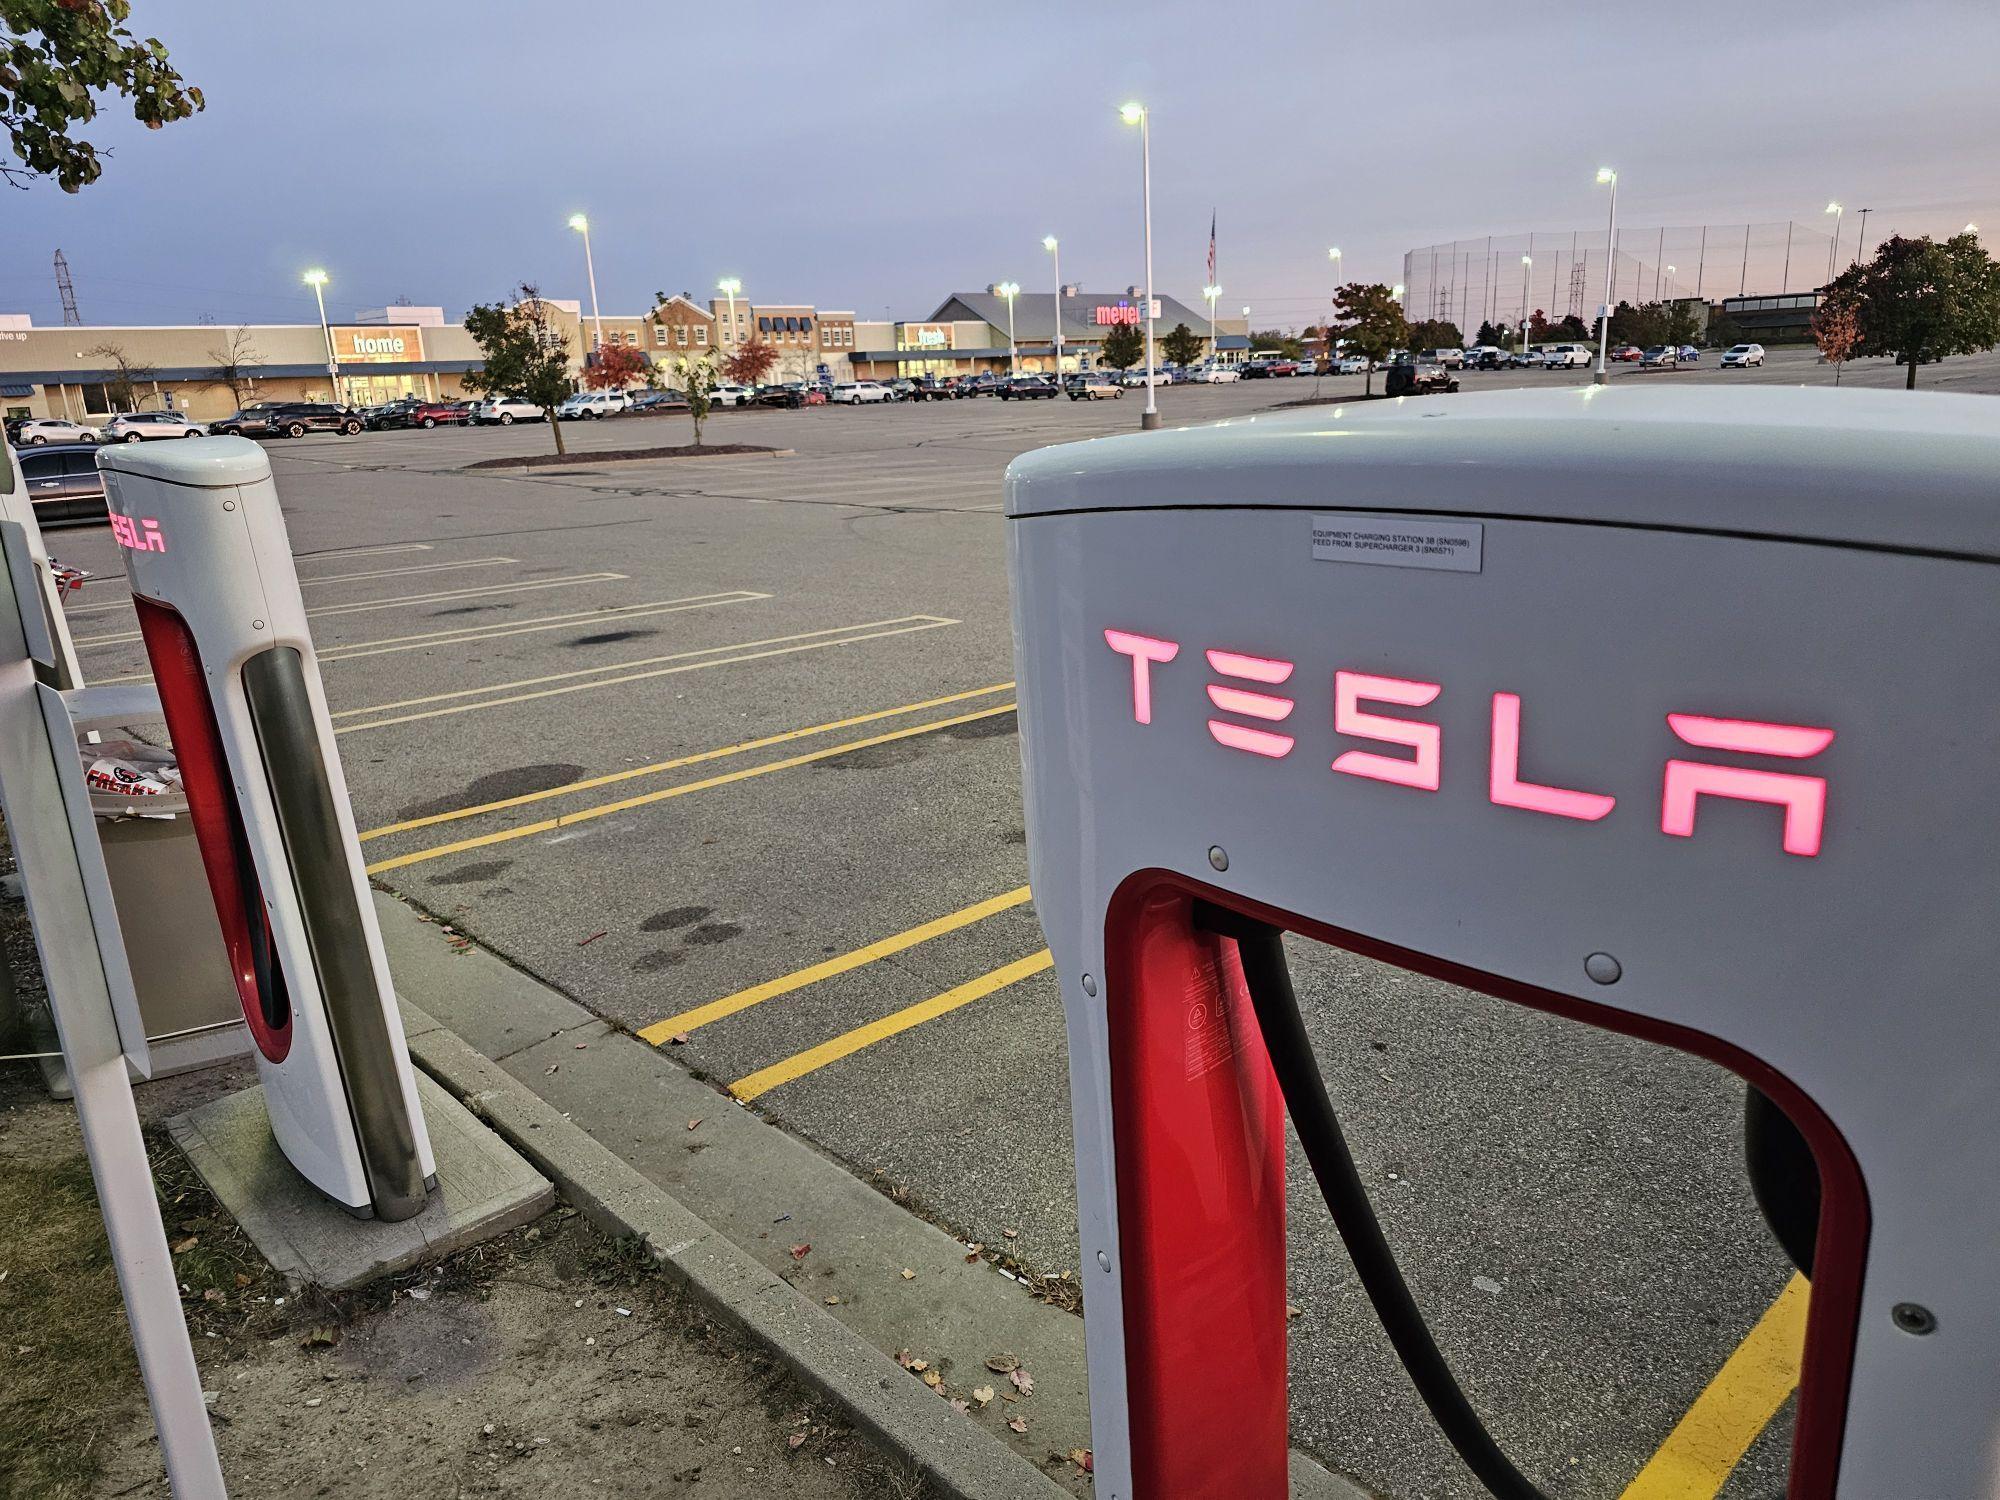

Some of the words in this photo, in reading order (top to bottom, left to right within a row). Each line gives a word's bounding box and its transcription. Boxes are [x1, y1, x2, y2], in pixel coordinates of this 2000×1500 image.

[16, 332, 27, 342] up
[353, 334, 404, 353] home
[1313, 530, 1352, 539] EQUIPMENT
[1353, 532, 1391, 542] CHARGING
[1392, 535, 1424, 544] STATION
[1332, 540, 1352, 548] FROM
[1355, 541, 1414, 552] SUPERCHARGER
[1415, 545, 1420, 553] 3
[1103, 628, 1835, 857] TESLA
